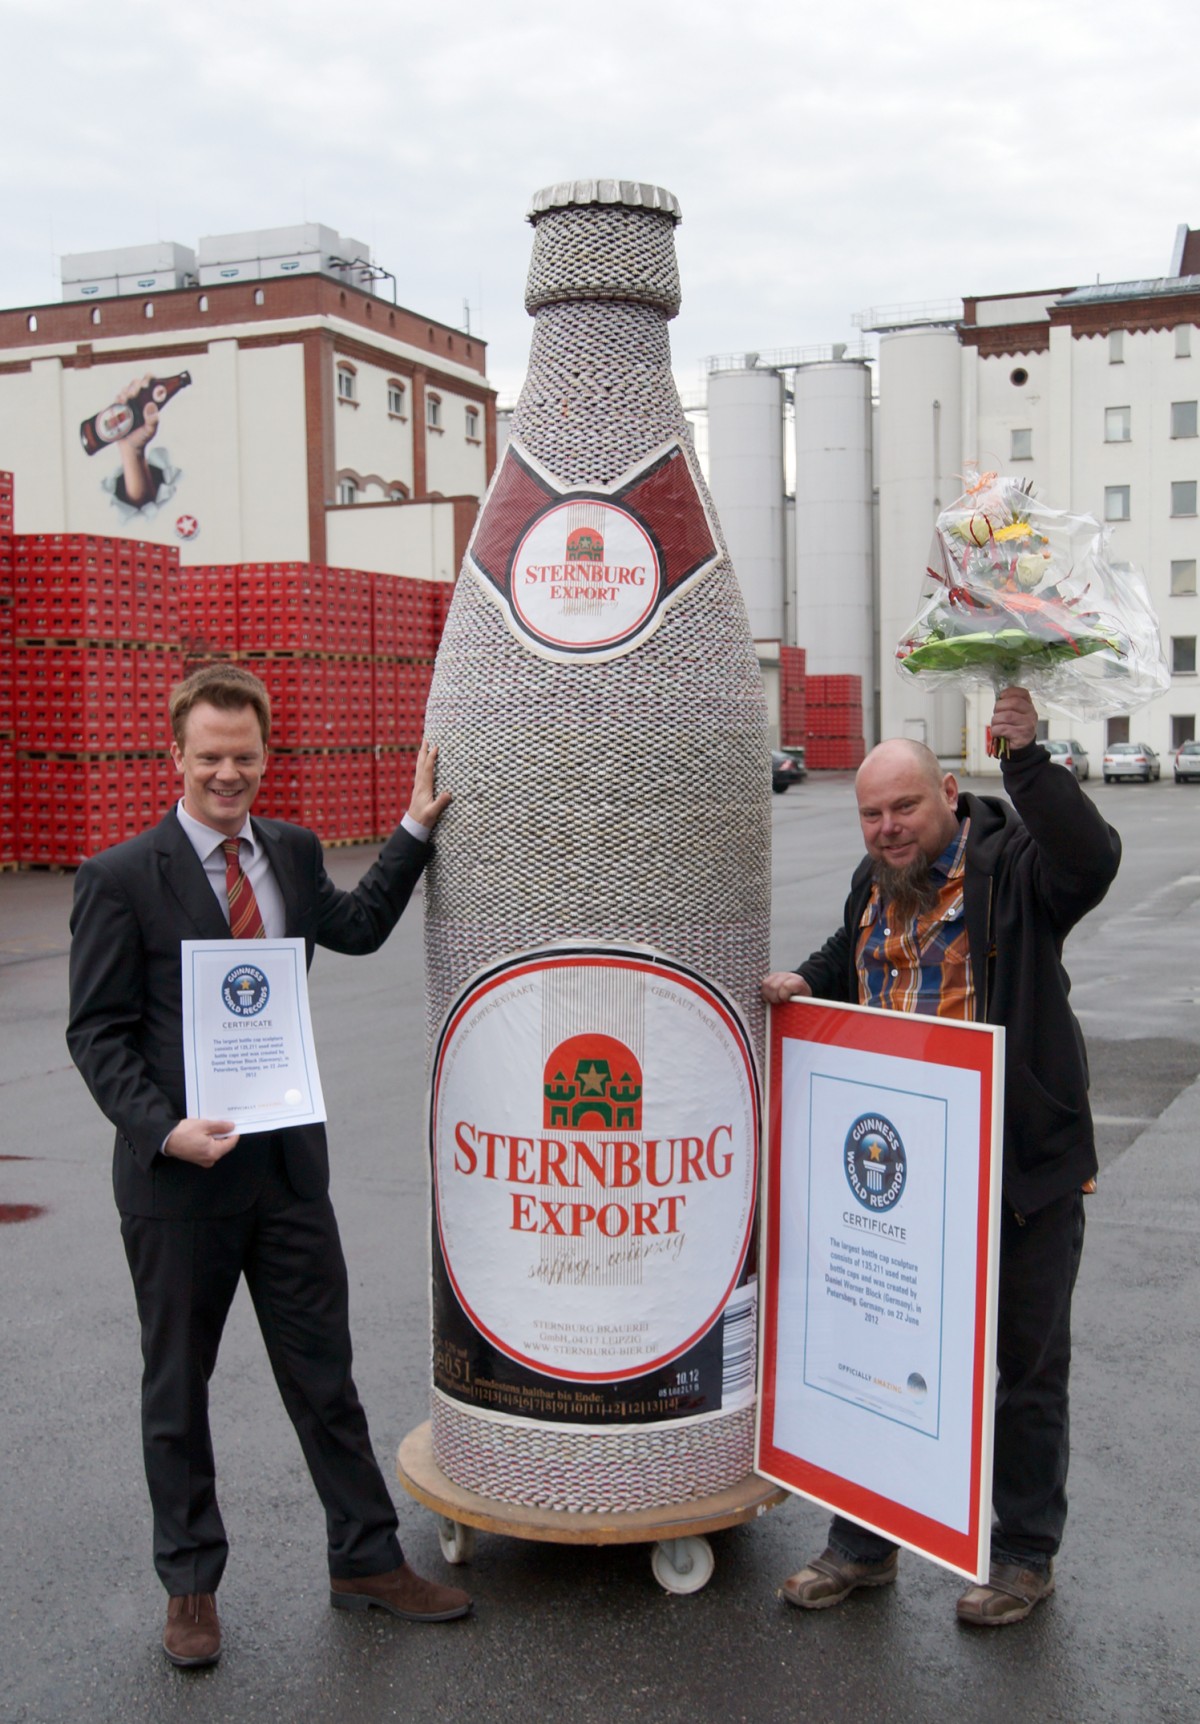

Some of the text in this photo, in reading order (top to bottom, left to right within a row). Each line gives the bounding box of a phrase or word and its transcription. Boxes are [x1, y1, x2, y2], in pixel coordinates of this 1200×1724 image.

[525, 564, 646, 586] STERNBURG
[550, 586, 620, 601] EXPORT
[227, 967, 264, 983] GUINNESS
[224, 986, 268, 1015] WORLD RECORDS
[651, 986, 695, 1011] GEBRAUT
[222, 1020, 272, 1029] CERTIFICATE
[852, 1119, 900, 1151] GUINNESS
[454, 1121, 735, 1189] STERNBURG
[847, 1151, 904, 1208] WORLD RECORDS
[510, 1193, 687, 1238] EXPORT
[842, 1211, 907, 1241] CERTIFICATE
[830, 1237, 918, 1272] The largest bottle cap sculpture
[830, 1251, 853, 1265] consists
[854, 1259, 860, 1267] of
[885, 1269, 899, 1280] used
[900, 1274, 917, 1285] metal
[825, 1273, 842, 1287] Daniel
[843, 1279, 864, 1294] Werner
[865, 1287, 881, 1299] Block
[830, 1263, 917, 1300] bottle caps and was created by
[533, 1320, 649, 1333] STERNBURG BRAUEREI
[864, 1312, 879, 1325] 2012
[887, 1309, 895, 1317] on
[896, 1310, 903, 1320] 22
[905, 1314, 919, 1326] June
[601, 1335, 642, 1345] LEIPZIG
[838, 1363, 903, 1394] OFFICIALLY AMAZING
